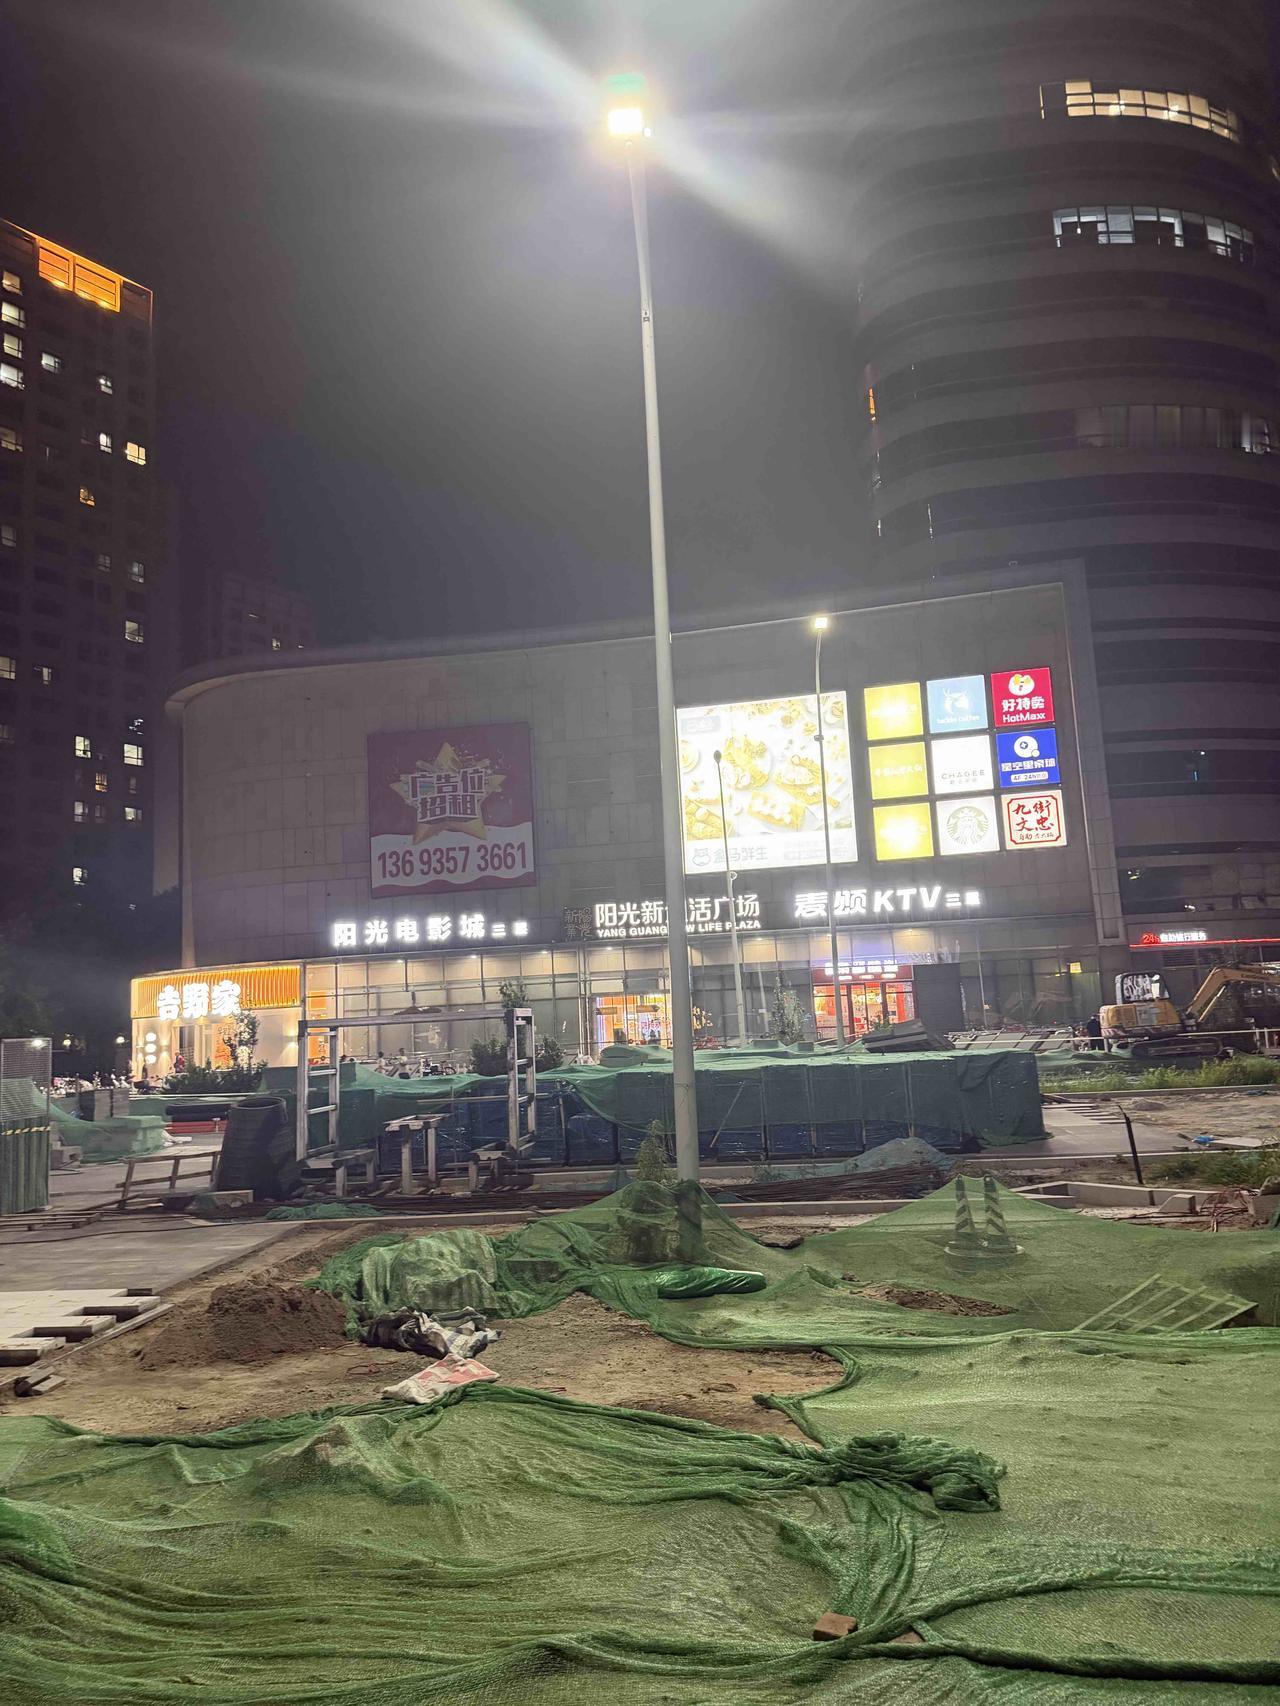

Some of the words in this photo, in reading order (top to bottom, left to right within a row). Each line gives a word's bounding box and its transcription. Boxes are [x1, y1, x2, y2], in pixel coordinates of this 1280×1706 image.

[1002, 712, 1047, 723] HotMaxx
[410, 769, 485, 800] 广告位
[417, 794, 478, 821] 招租
[378, 850, 414, 878] 136
[419, 846, 470, 875] 9357
[476, 842, 527, 871] 3661
[595, 894, 759, 927] 阳光新活广场
[597, 928, 626, 938] YANG
[630, 926, 667, 936] GUANG
[698, 922, 722, 932] LIFE
[158, 980, 240, 1020] 吉野家
